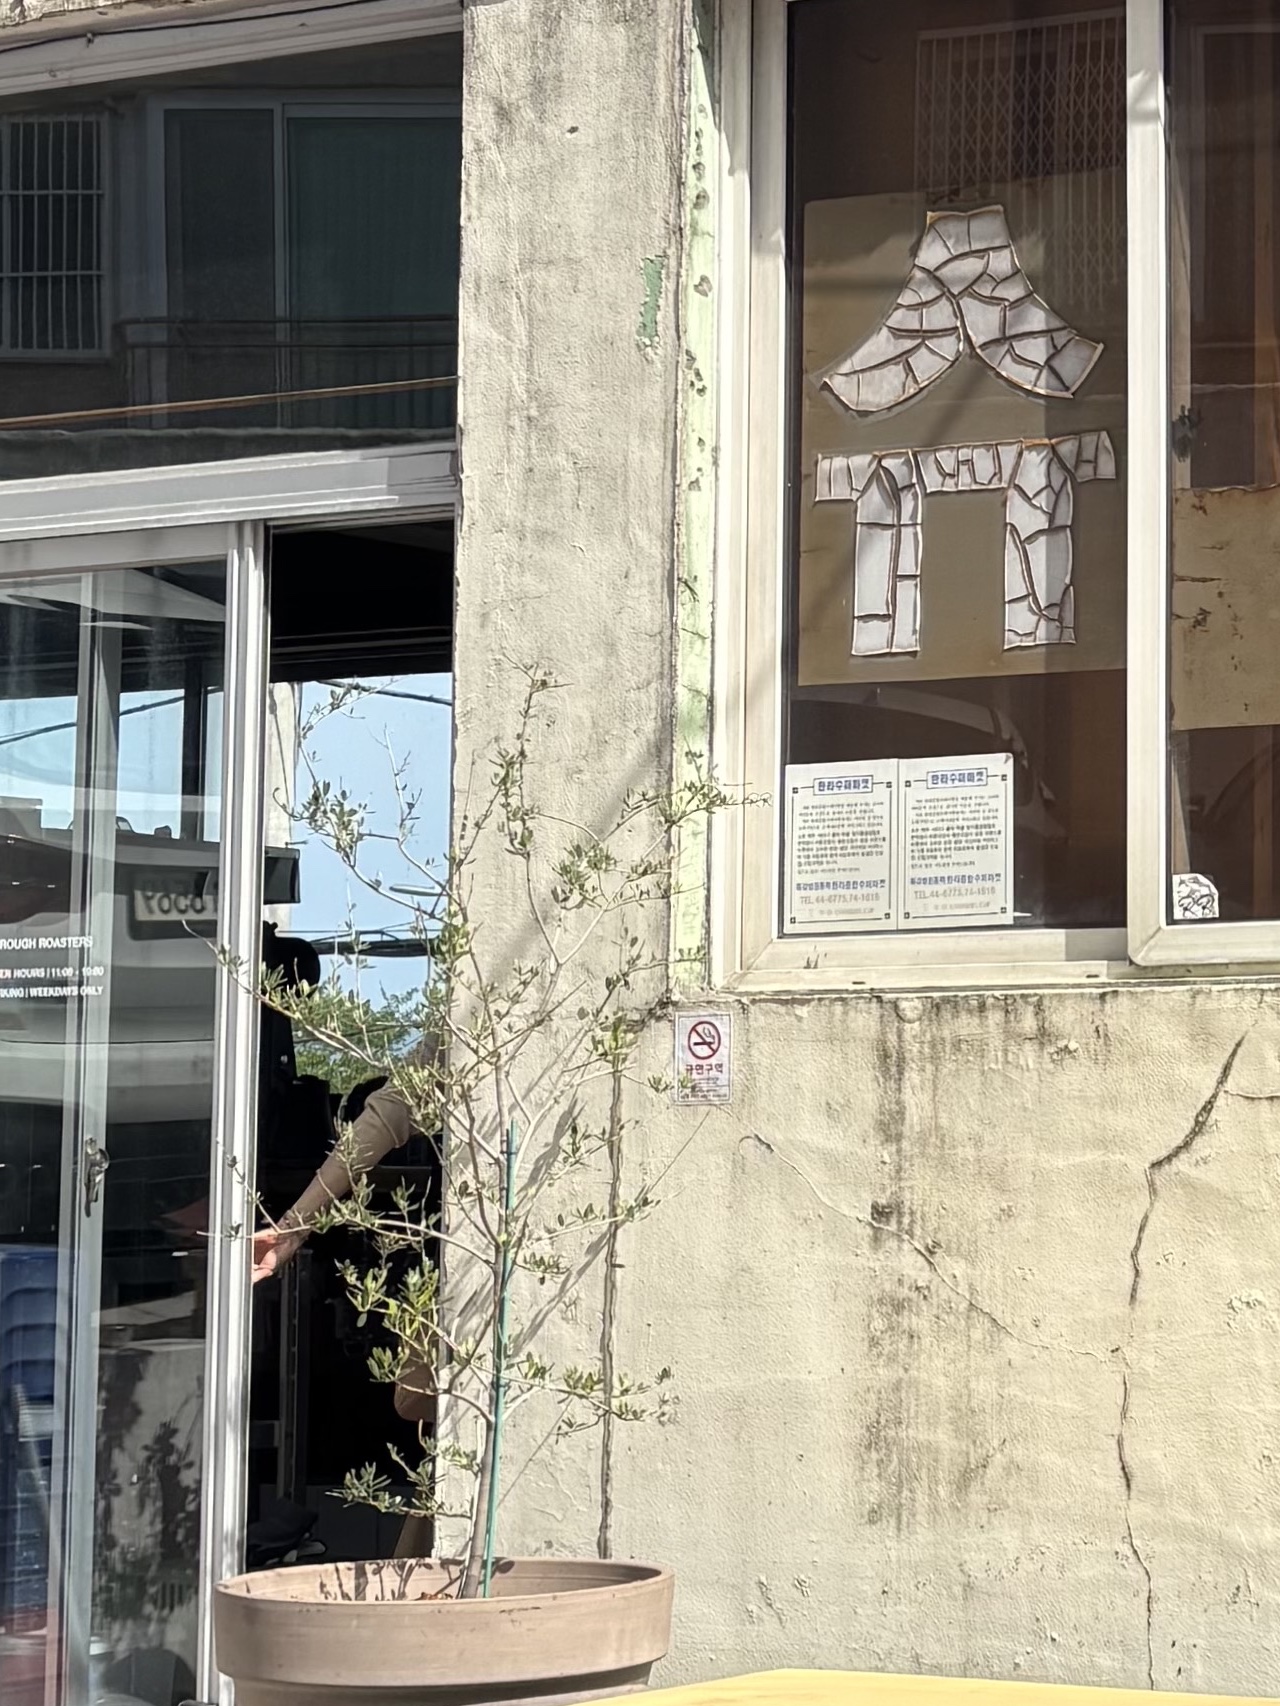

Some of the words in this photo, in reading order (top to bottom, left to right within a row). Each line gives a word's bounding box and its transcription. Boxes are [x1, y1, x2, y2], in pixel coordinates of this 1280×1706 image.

[38, 935, 93, 949] ROASTERS
[13, 967, 45, 979] HOURS
[29, 986, 78, 998] WEEKDAYS
[80, 985, 103, 996] ONLY
